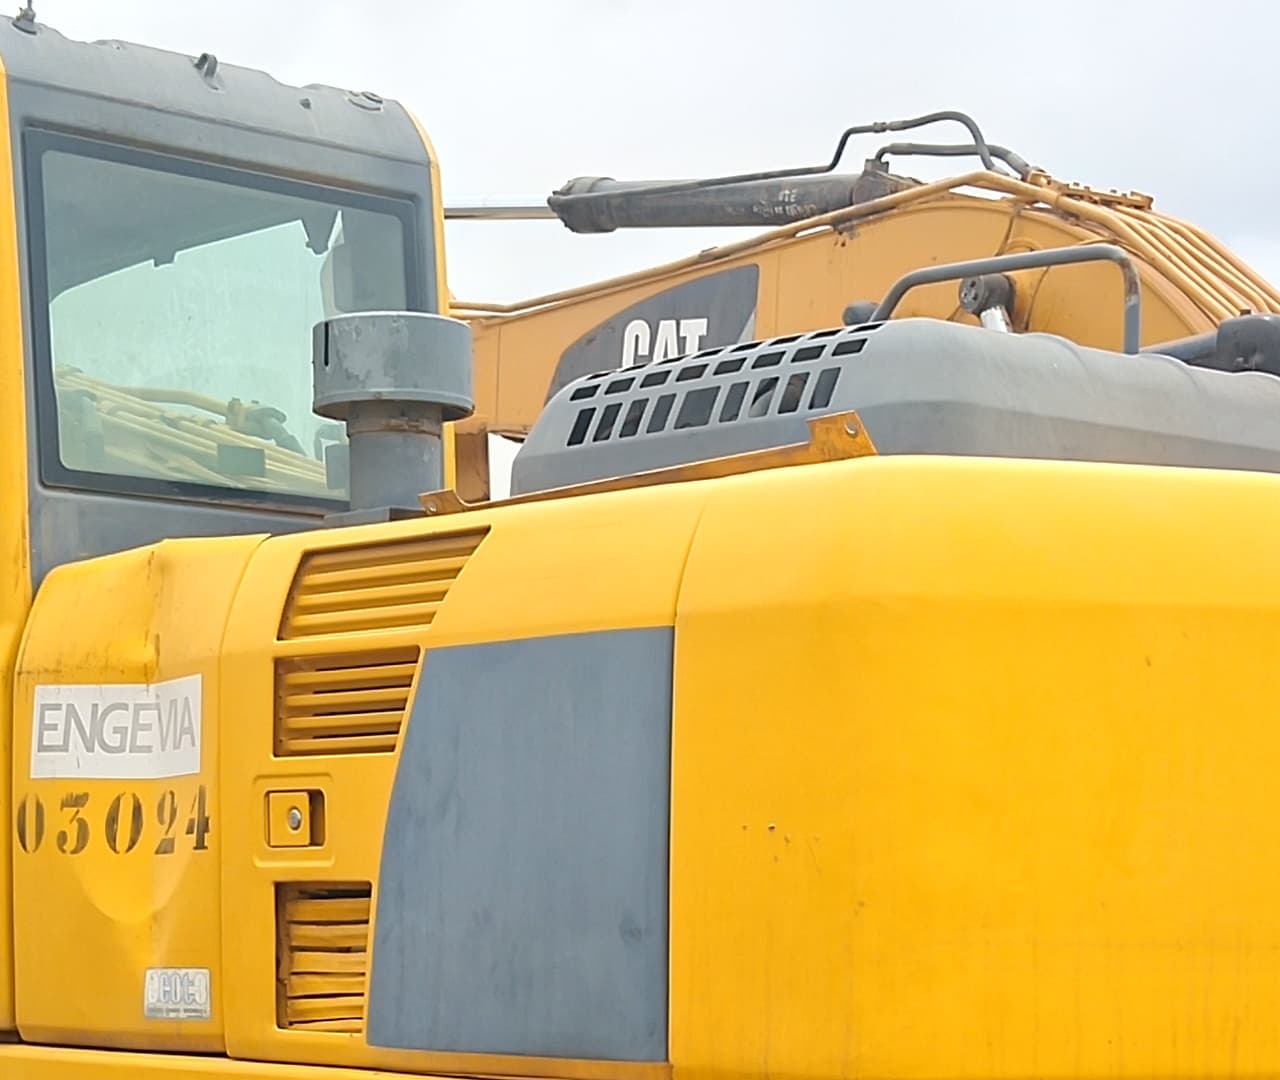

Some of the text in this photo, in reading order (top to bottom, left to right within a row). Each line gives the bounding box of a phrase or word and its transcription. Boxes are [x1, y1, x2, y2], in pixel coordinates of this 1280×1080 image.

[623, 318, 708, 372] CAT
[37, 694, 196, 754] ENGEVIA
[17, 784, 210, 855] 03024
